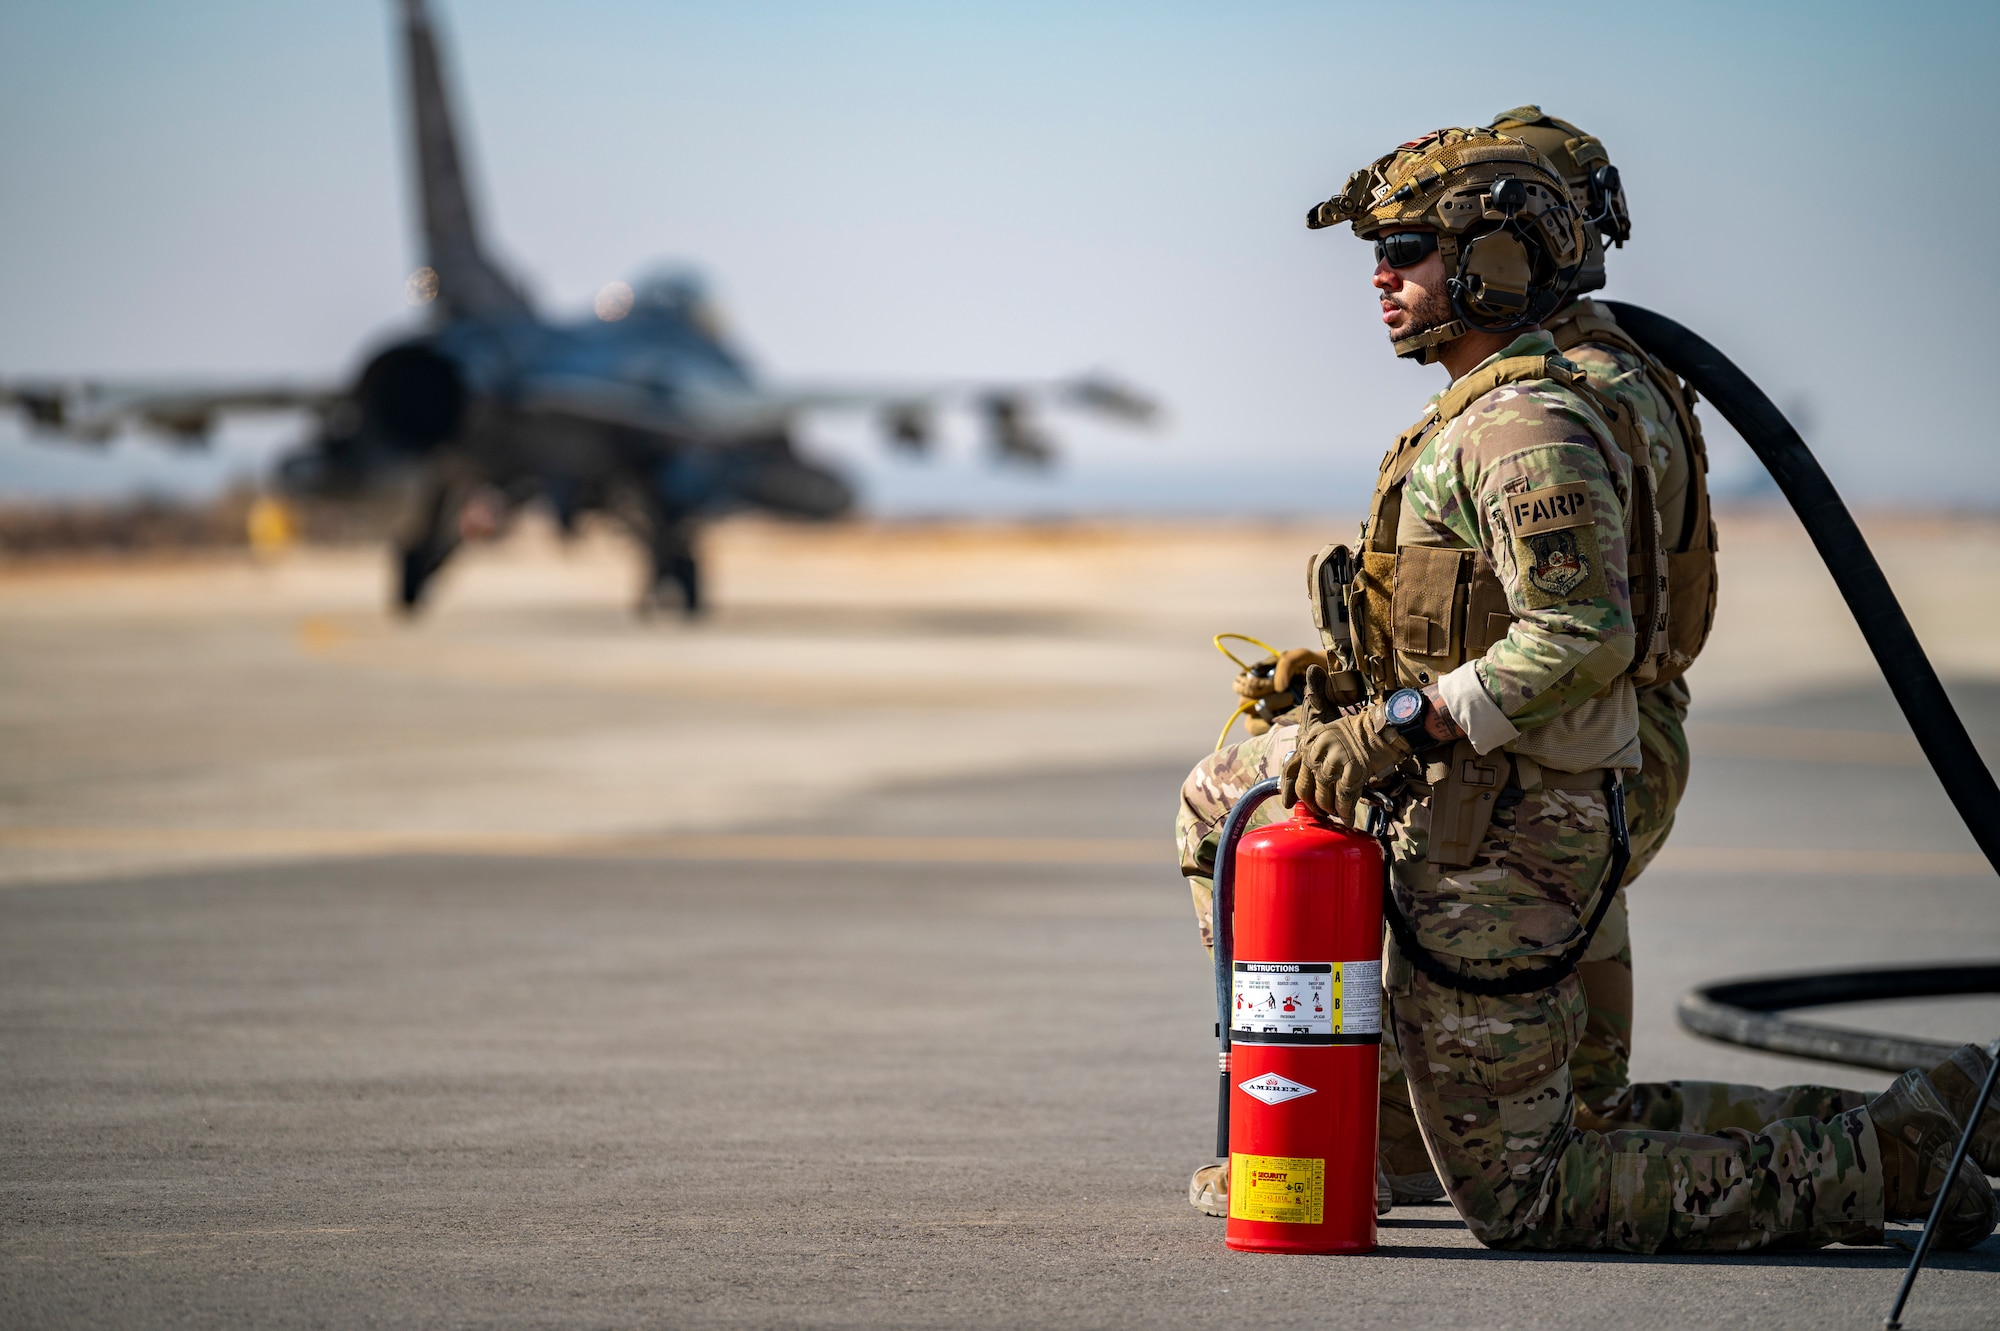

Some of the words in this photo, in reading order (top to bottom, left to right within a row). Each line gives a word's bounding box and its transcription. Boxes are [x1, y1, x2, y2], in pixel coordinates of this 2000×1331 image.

[1513, 492, 1585, 527] FARP
[1247, 964, 1300, 973] INSTRUCTIONS
[1334, 971, 1340, 983] A
[1335, 998, 1340, 1010] B
[1248, 1084, 1300, 1093] AMEREX
[1258, 1172, 1288, 1180] SECURITY
